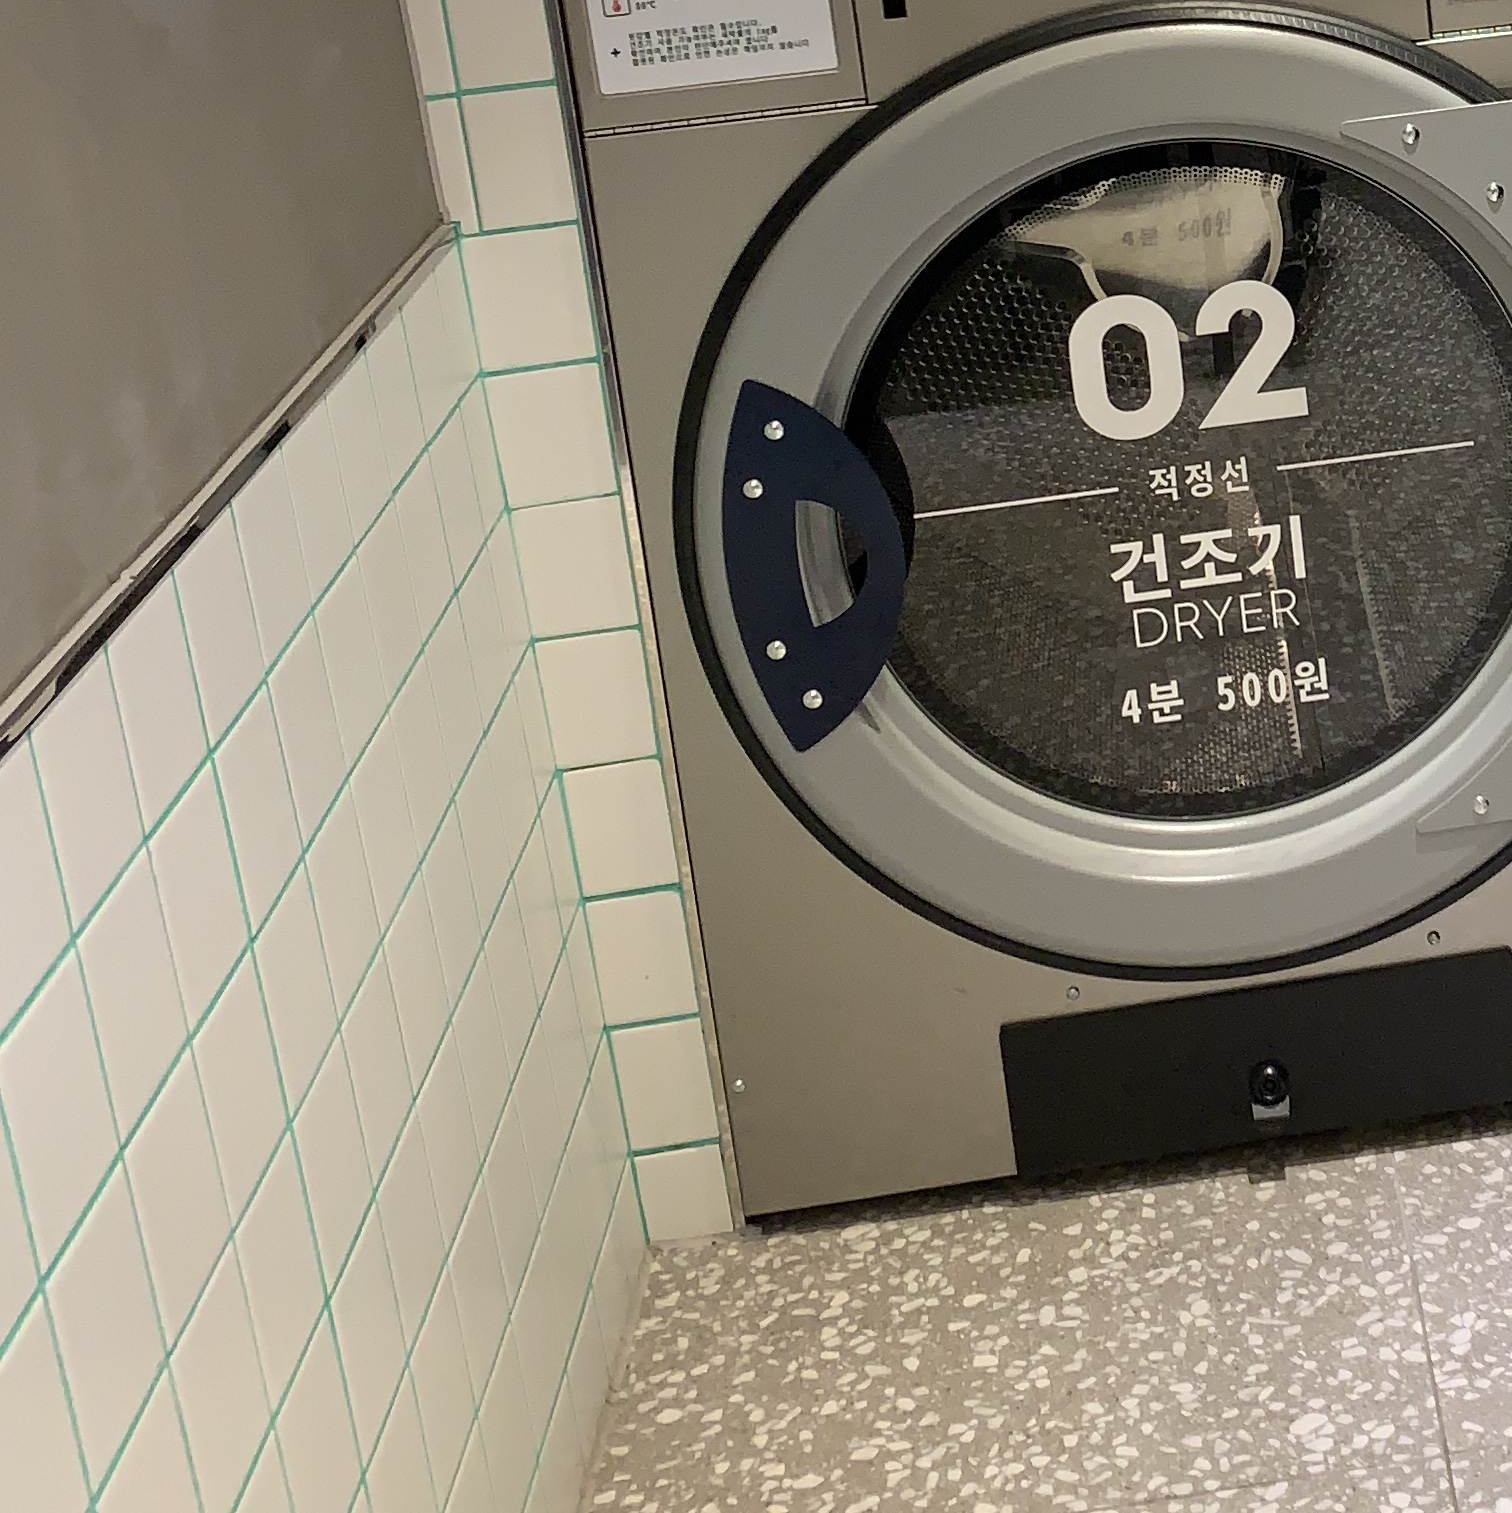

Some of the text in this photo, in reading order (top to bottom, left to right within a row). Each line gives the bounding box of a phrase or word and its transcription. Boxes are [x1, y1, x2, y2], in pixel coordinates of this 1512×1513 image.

[1068, 279, 1309, 441] 02
[1149, 456, 1250, 501] 적정선
[1110, 515, 1306, 603] 건조기
[1132, 589, 1300, 648] DRYER
[1121, 657, 1330, 725] 4분 500원
